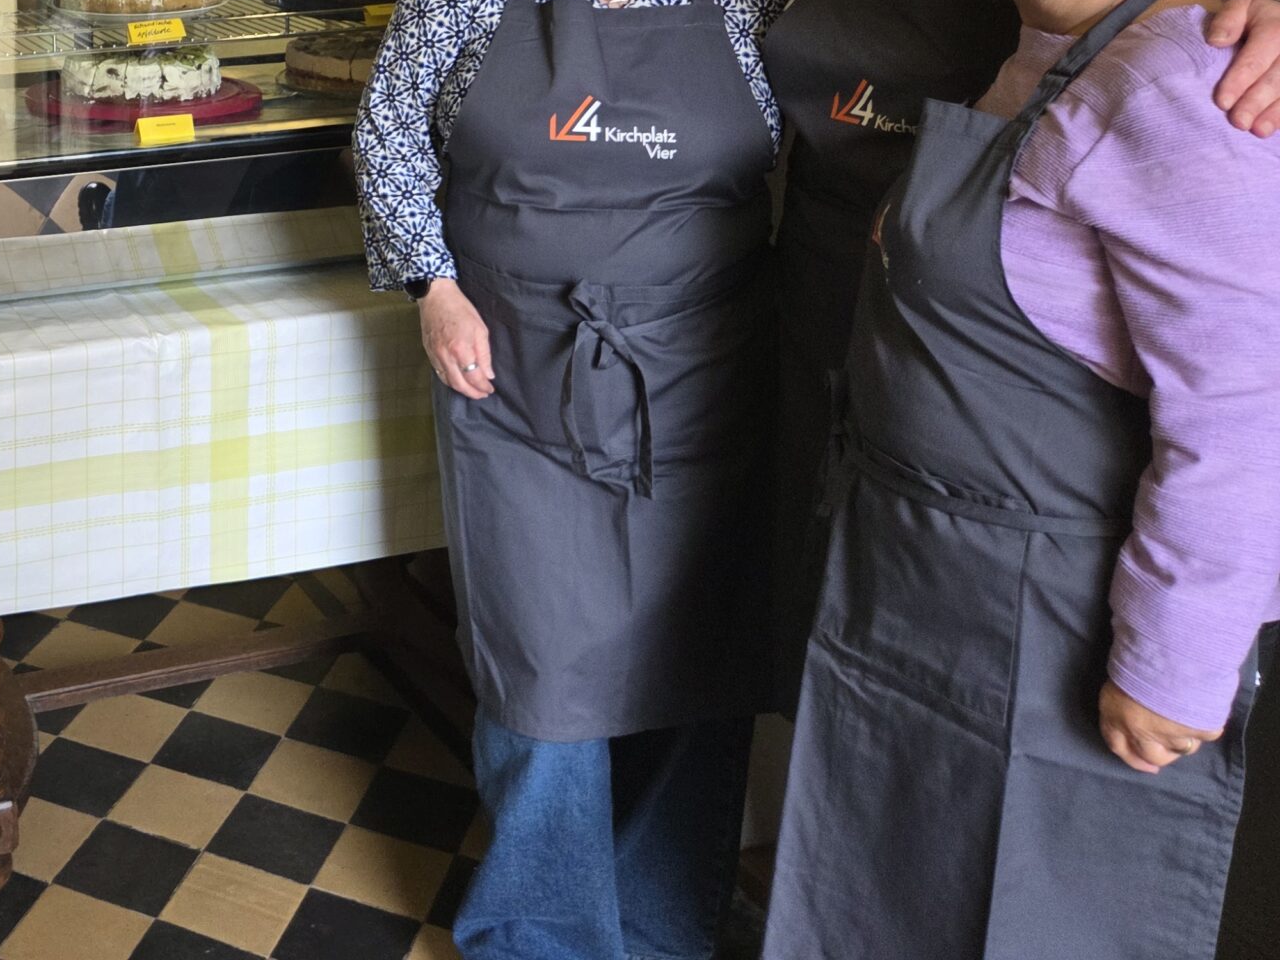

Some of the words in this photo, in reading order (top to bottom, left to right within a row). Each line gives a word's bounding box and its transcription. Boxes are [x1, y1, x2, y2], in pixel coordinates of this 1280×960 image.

[571, 100, 602, 142] 4
[605, 125, 677, 146] Kirchplatz
[850, 84, 875, 127] 4
[645, 143, 677, 160] Vier
